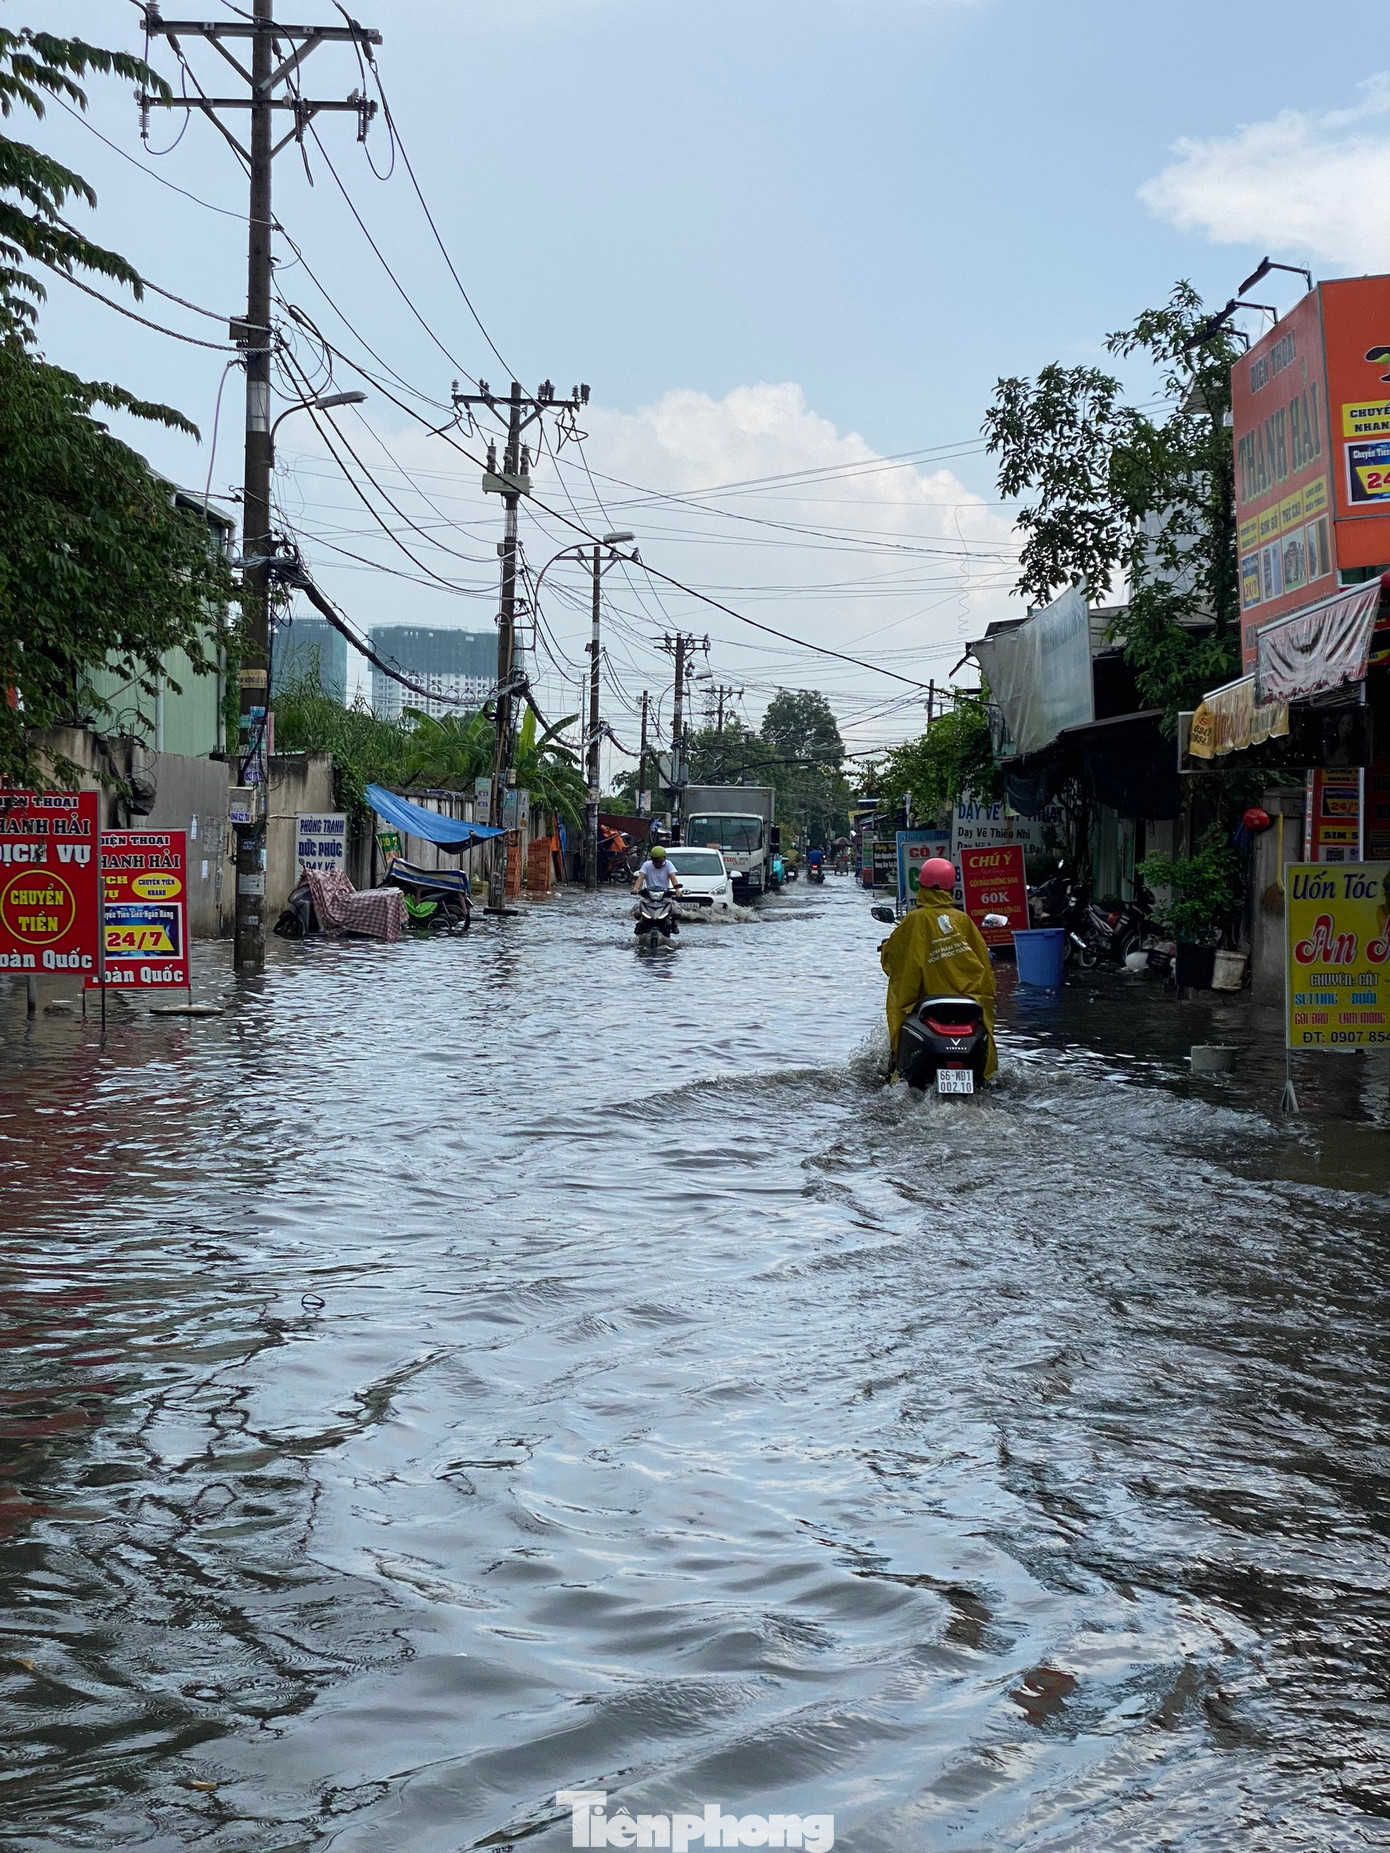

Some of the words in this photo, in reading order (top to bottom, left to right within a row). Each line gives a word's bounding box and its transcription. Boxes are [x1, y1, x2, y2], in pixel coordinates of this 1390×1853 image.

[1354, 421, 1390, 433] NHAN
[1238, 406, 1289, 507] THANH
[32, 796, 79, 811] THOẠI
[0, 818, 50, 836] HANH
[52, 812, 91, 836] HẢI
[300, 816, 322, 833] PHÒNG
[323, 819, 345, 834] TRANH
[958, 826, 973, 838] Dạy
[1016, 829, 1030, 839] Nhi
[129, 835, 170, 848] THOẠI
[1324, 831, 1347, 840] SIM
[0, 843, 47, 868] ỊCH
[56, 844, 91, 868] VỤ
[101, 853, 145, 869] HANH
[147, 848, 181, 869] HẢI
[936, 846, 946, 856] 7
[969, 852, 1000, 868] CHÚ
[1003, 851, 1013, 865] Ý
[10, 882, 64, 905] CHUYỂN
[1293, 870, 1336, 900] Uốn
[1344, 873, 1378, 899] Tóc
[981, 892, 1010, 904] 60K
[18, 910, 58, 932] TIỀN
[107, 931, 163, 950] 24/7
[1294, 912, 1358, 966] An
[0, 948, 36, 968] oàn
[42, 946, 93, 970] Quốc
[140, 963, 184, 984] Quốc
[1302, 1031, 1326, 1043] ĐT:
[1330, 1031, 1364, 1043] 0907
